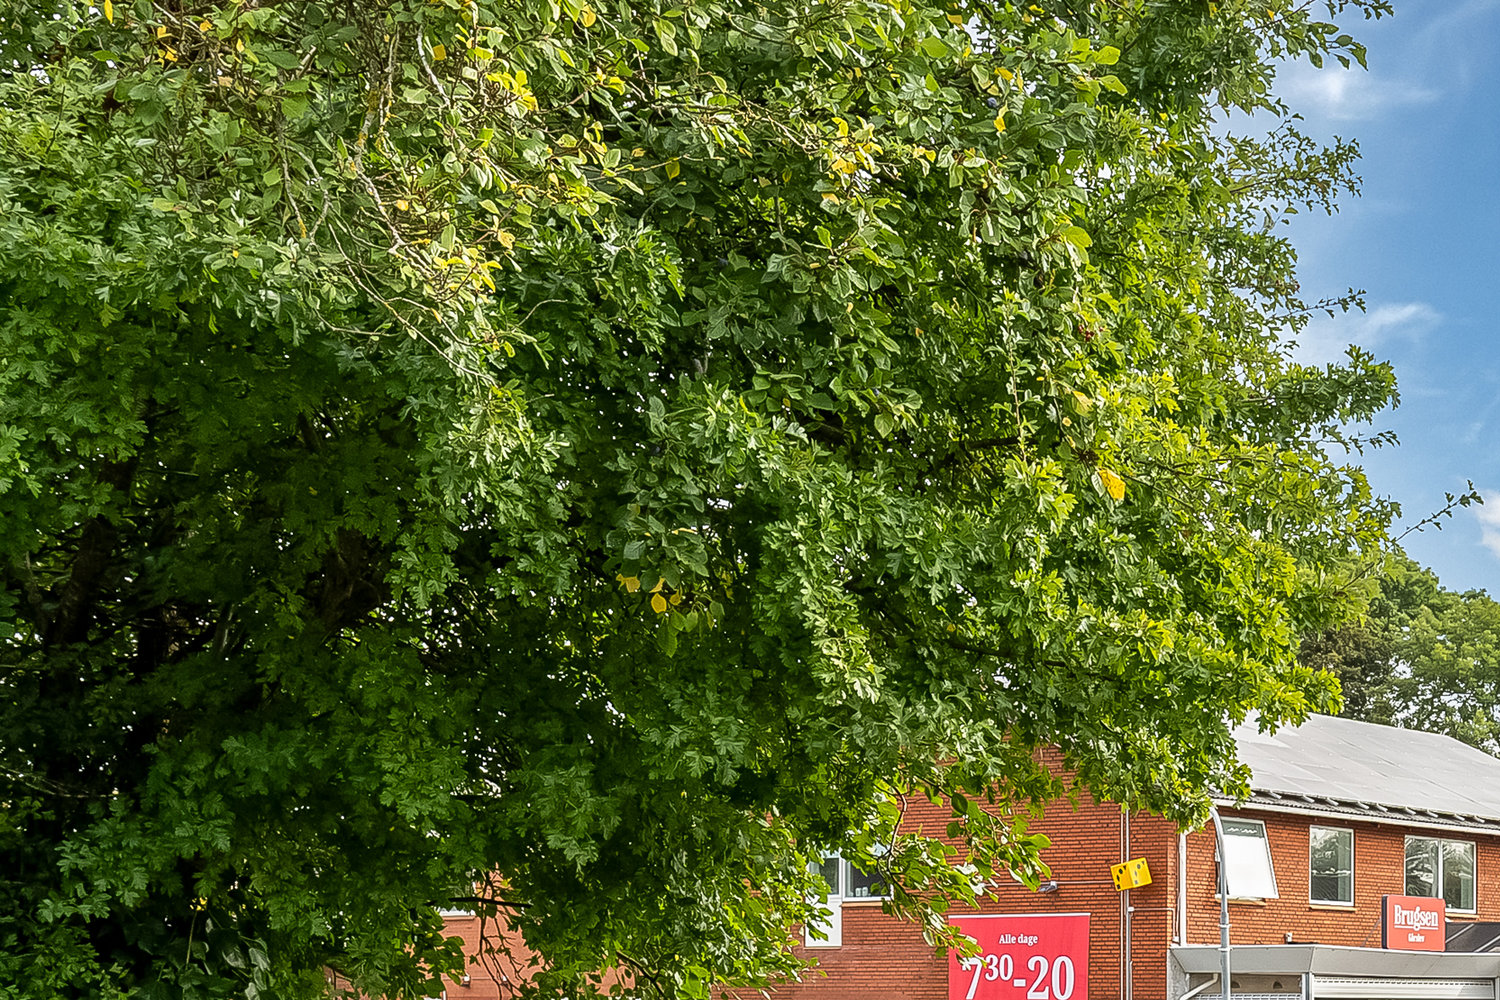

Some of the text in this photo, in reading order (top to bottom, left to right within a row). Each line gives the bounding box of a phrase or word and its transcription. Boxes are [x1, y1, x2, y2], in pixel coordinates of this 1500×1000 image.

[1394, 904, 1439, 931] Brugsen
[999, 934, 1038, 946] Alle dage
